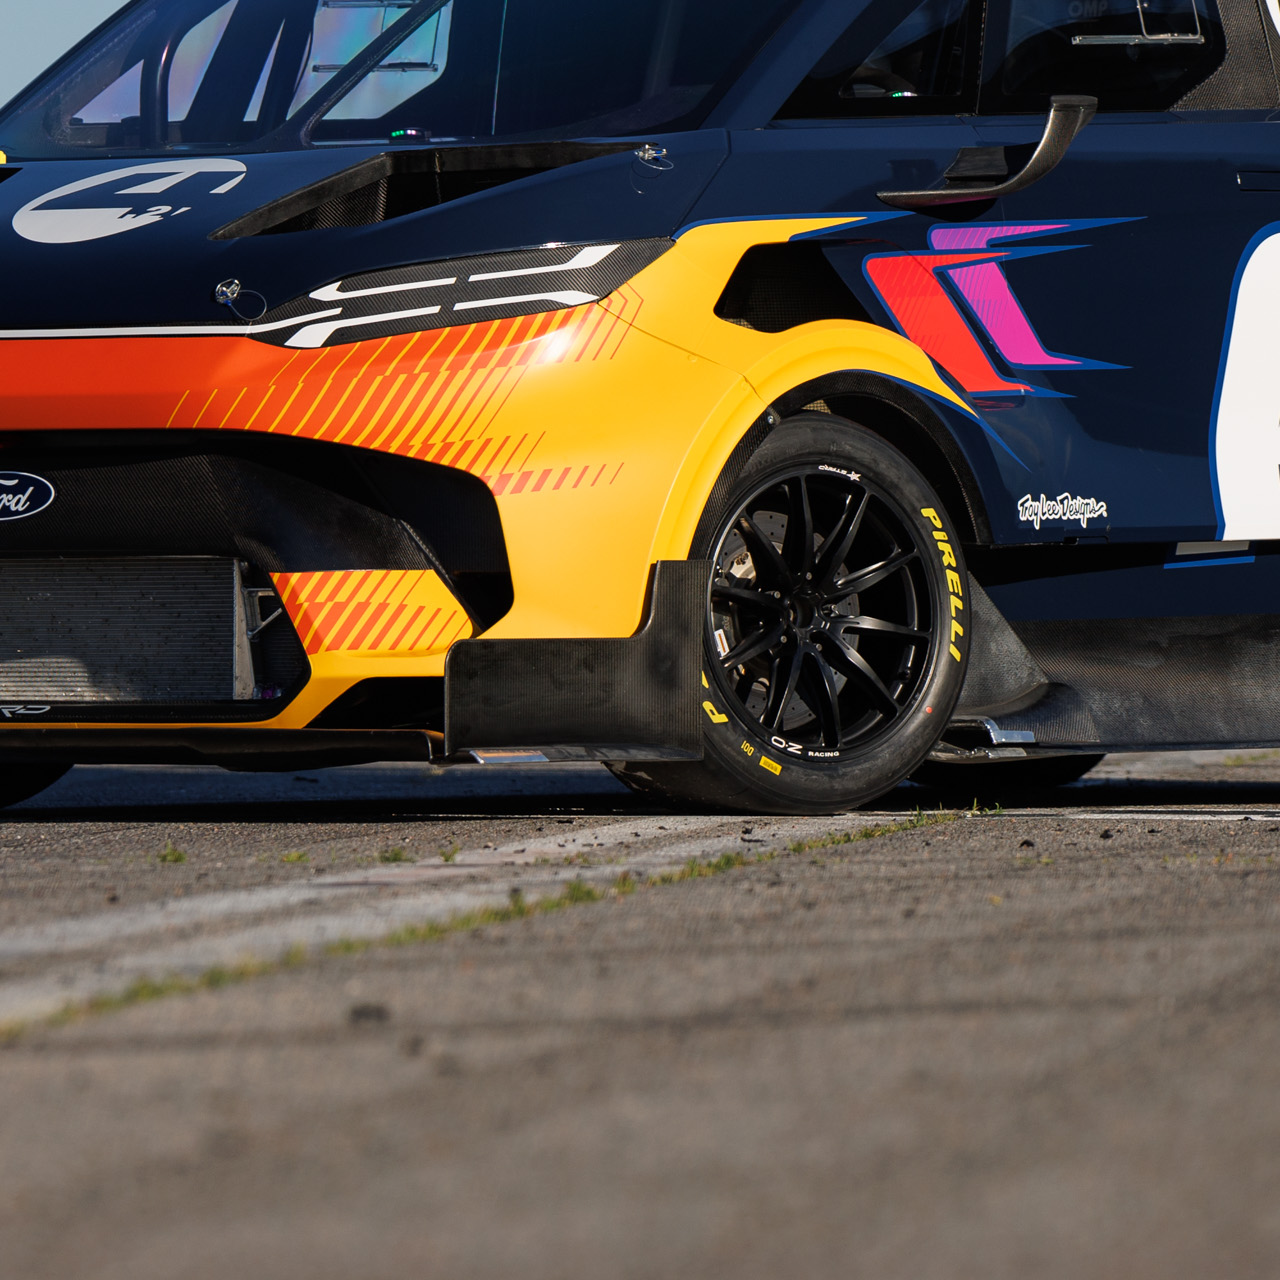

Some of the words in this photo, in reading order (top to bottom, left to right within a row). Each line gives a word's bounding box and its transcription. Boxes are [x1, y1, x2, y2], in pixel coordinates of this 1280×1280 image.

[1068, 0, 1109, 18] OMP
[1018, 494, 1041, 530] Troy
[1039, 494, 1061, 520] Lee
[920, 507, 964, 663] PIRELLI
